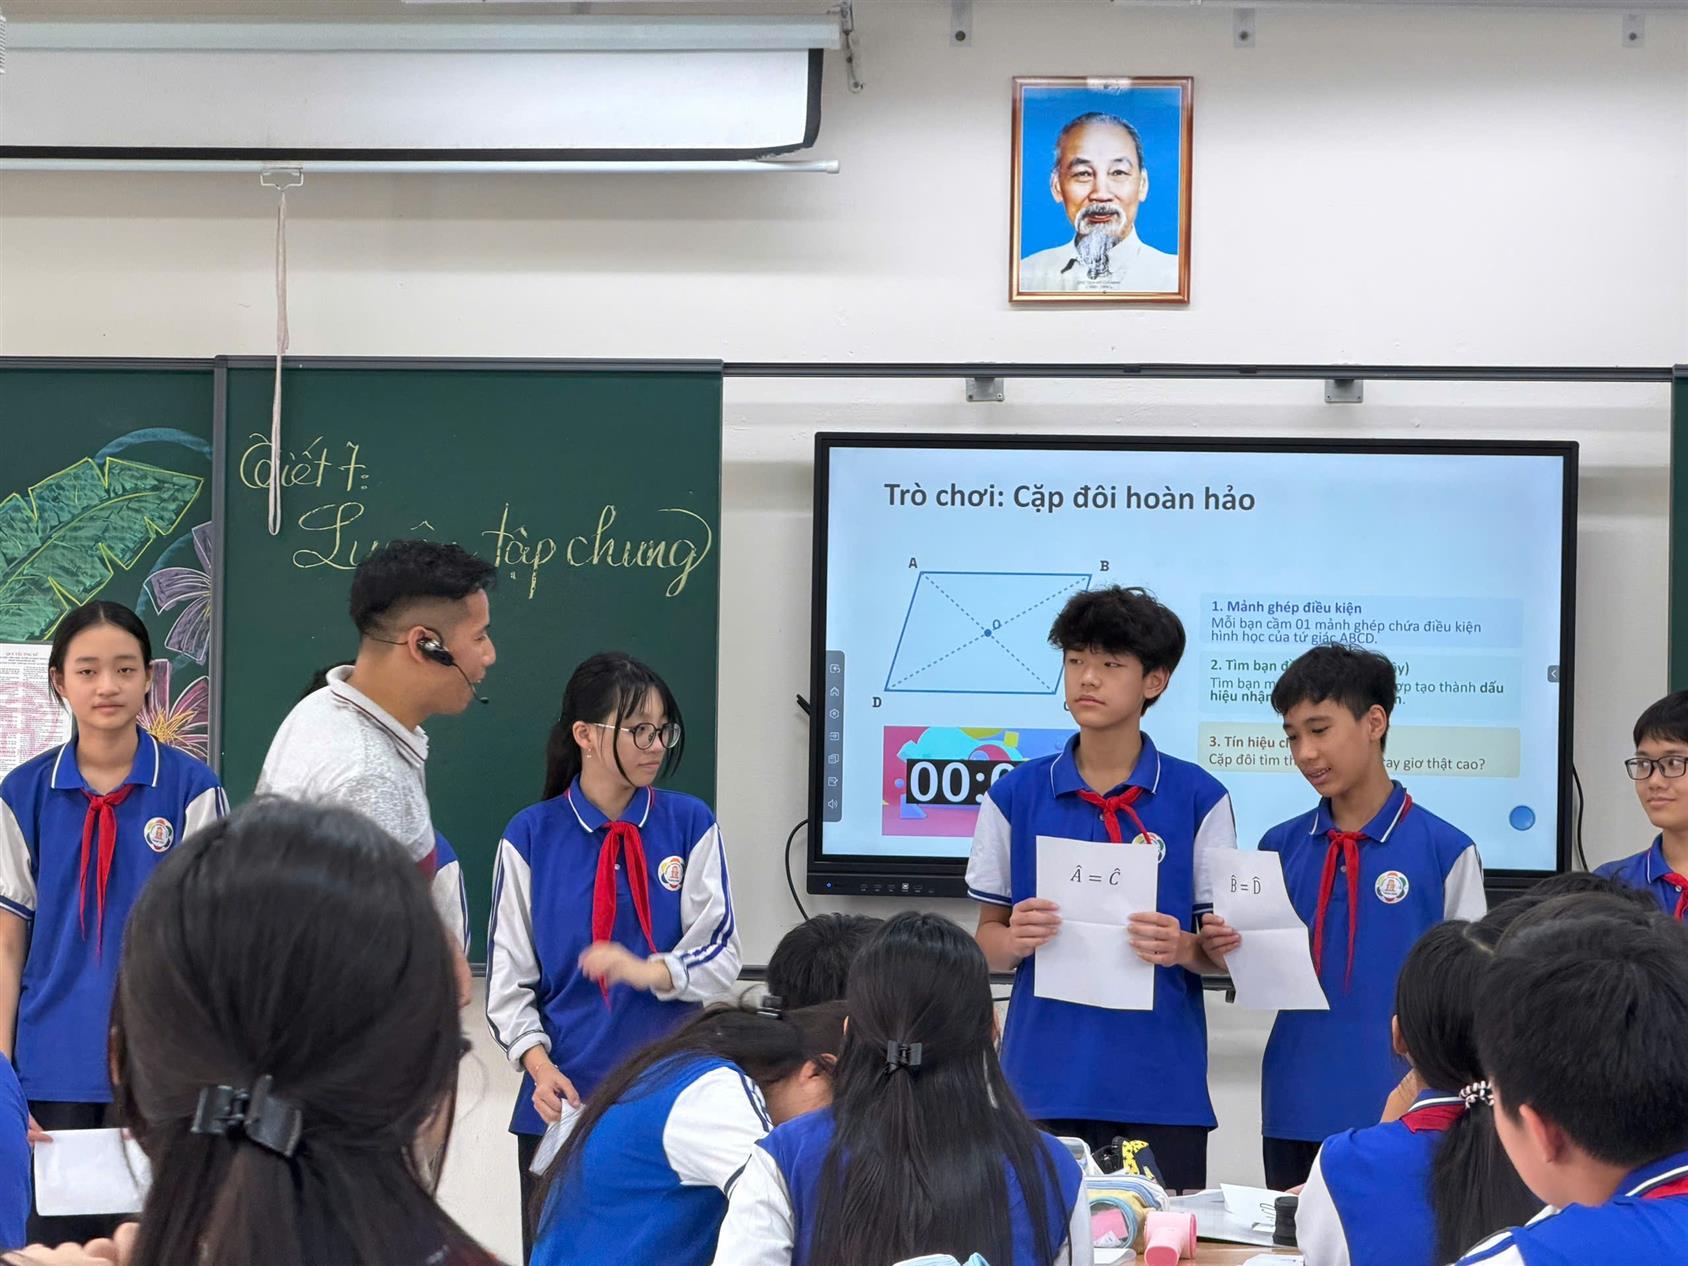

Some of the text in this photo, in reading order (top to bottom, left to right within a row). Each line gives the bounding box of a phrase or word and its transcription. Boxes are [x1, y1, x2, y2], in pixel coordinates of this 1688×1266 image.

[338, 441, 369, 492] 7:
[885, 483, 1256, 513] Trò chơi: Cặp đôi hoàn hảo
[567, 505, 712, 596] chung
[908, 557, 918, 569] A
[1100, 560, 1110, 572] B
[1211, 600, 1362, 616] 1. Mảnh ghép điều kiện
[1211, 614, 1236, 629] Mỗi
[1240, 617, 1263, 631] bạn
[1295, 619, 1311, 630] 01
[1315, 618, 1350, 631] mảnh
[1354, 619, 1385, 634] ghép
[1388, 620, 1420, 633] chứa
[1423, 619, 1451, 633] điều
[1455, 621, 1482, 635] kiện
[1211, 630, 1378, 646] hình học của tứ giác ABCD.
[1210, 659, 1222, 671] 2.
[1225, 658, 1249, 671] Tìm
[1253, 660, 1277, 673] bạn
[1210, 677, 1234, 689] Tìm
[1237, 678, 1260, 691] bạn
[1415, 682, 1436, 694] tạo
[1439, 681, 1476, 694] thành
[1480, 680, 1504, 694] dấu
[872, 697, 882, 708] D
[1210, 690, 1238, 703] hiệu
[1209, 736, 1221, 747] 3.
[1224, 736, 1244, 748] Tín
[1248, 736, 1275, 750] hiệu
[1209, 753, 1232, 767] Cặp
[1236, 754, 1256, 766] đôi
[1259, 754, 1280, 766] tìm
[1403, 757, 1423, 771] giơ
[1427, 757, 1453, 771] thật
[1456, 758, 1486, 770] cao?
